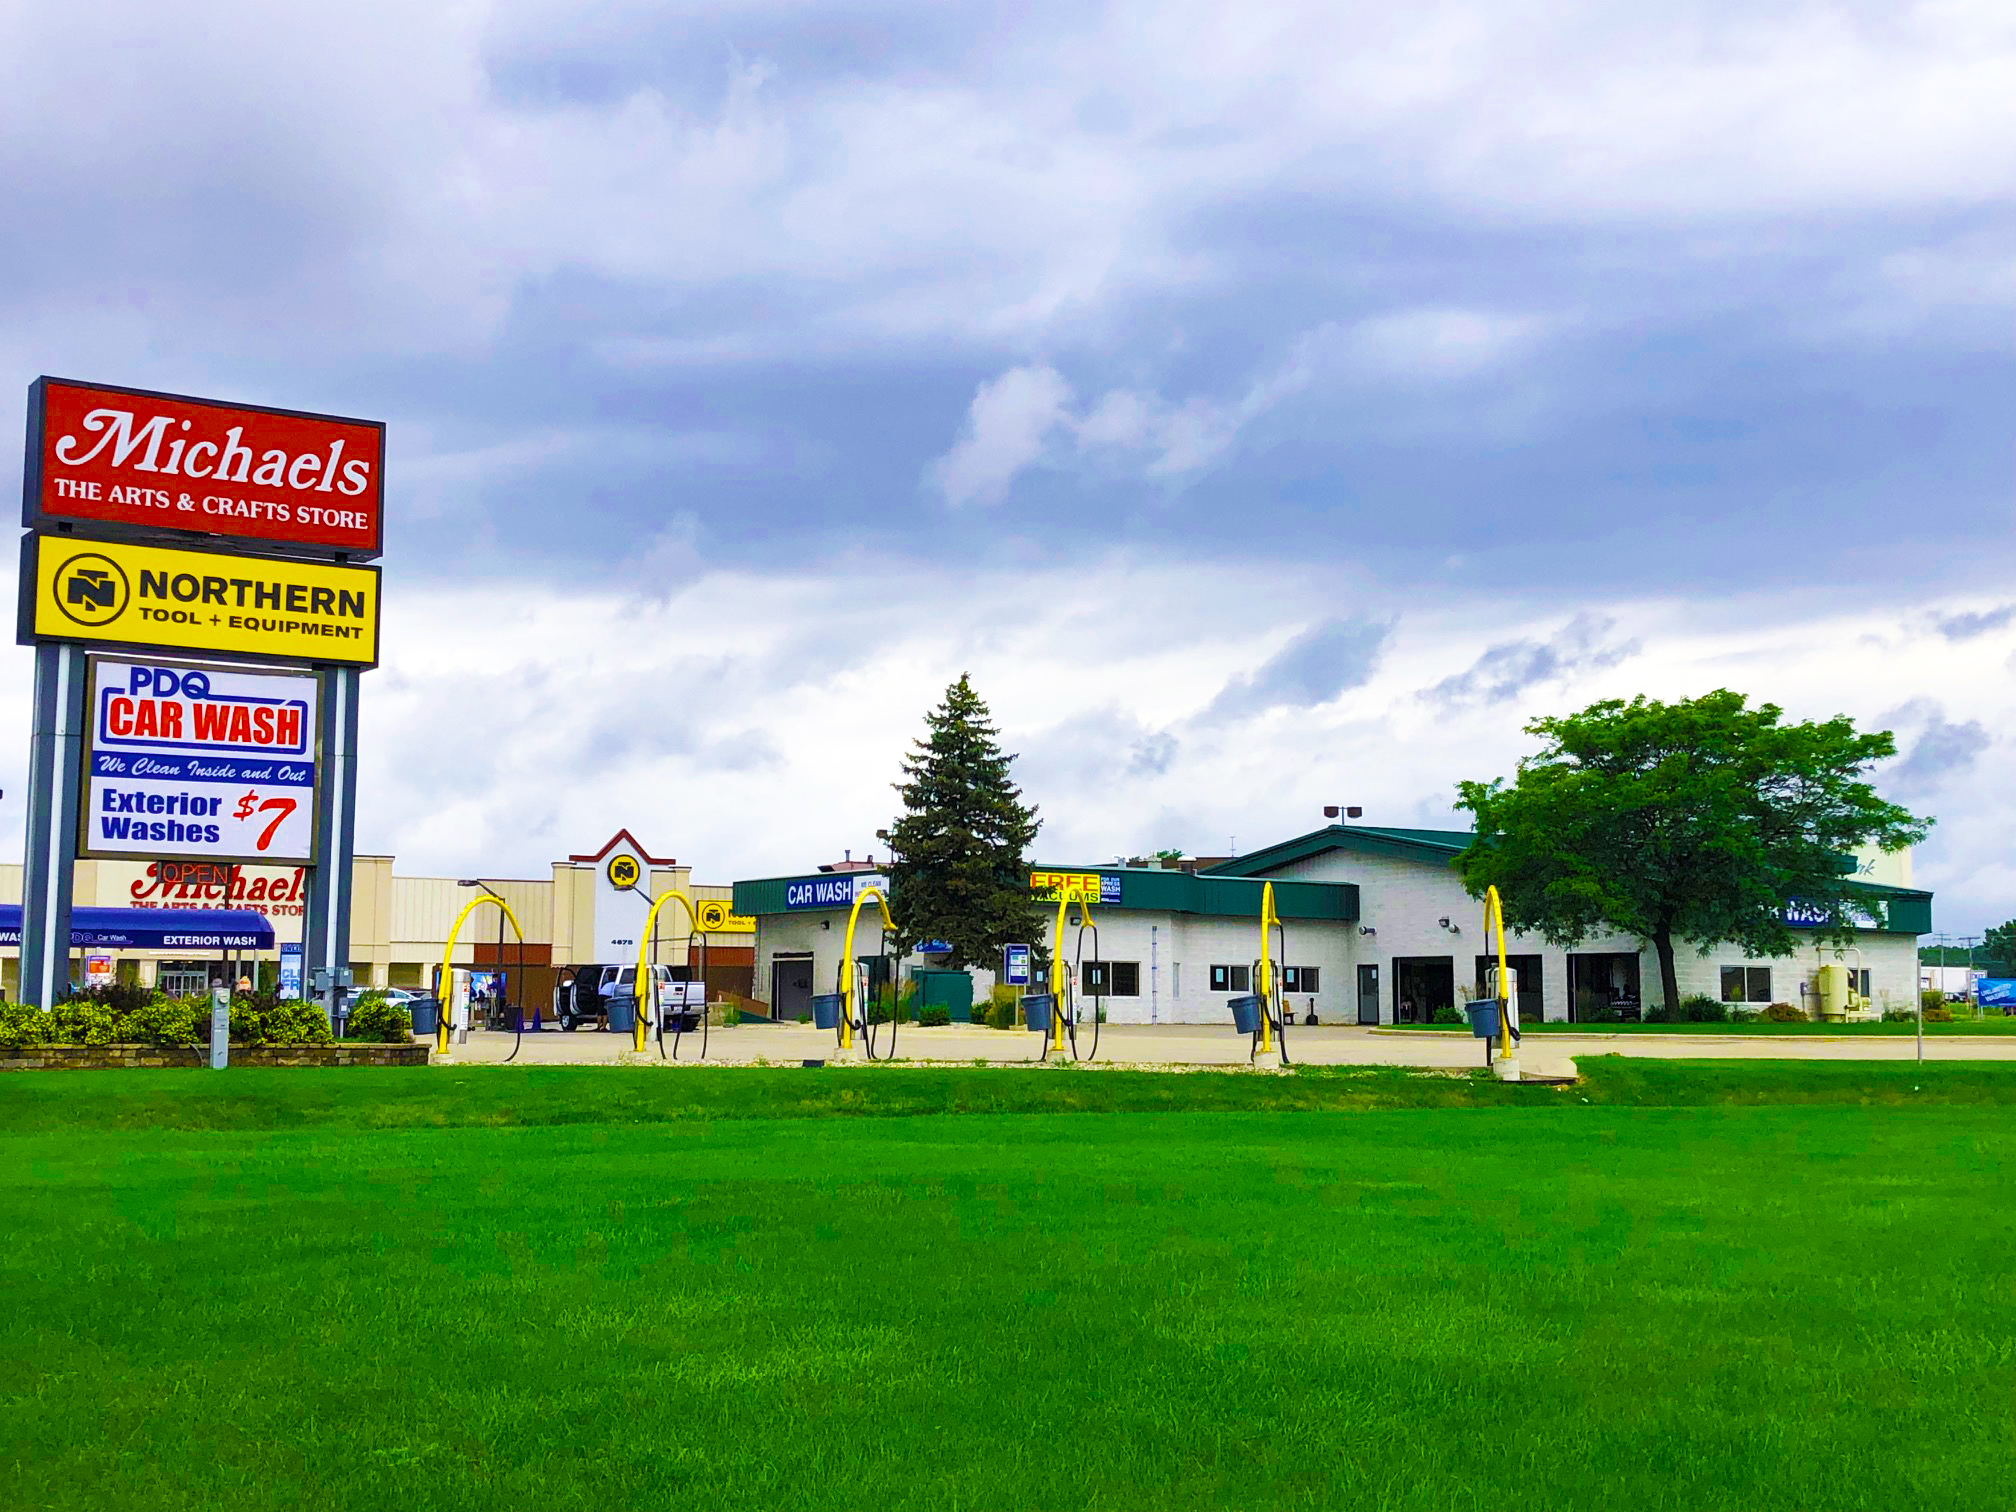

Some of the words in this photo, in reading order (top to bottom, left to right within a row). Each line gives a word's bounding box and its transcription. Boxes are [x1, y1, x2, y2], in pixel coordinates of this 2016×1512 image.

[55, 408, 370, 496] Michaels
[54, 478, 102, 501] THE
[108, 485, 170, 508] ARTS
[177, 493, 195, 511] &
[202, 496, 290, 521] CRAFTS
[297, 506, 369, 530] STORE
[139, 569, 365, 618] NORTHERN
[138, 607, 202, 625] TOOL
[209, 614, 222, 627] +
[229, 615, 364, 639] EQUIPMENT
[129, 666, 211, 699] PDQ
[109, 697, 183, 739] CAR
[193, 703, 299, 745] WASH
[99, 755, 126, 772] We
[131, 757, 181, 776] Clean
[187, 760, 236, 778] Inside
[241, 767, 272, 780] and
[277, 765, 307, 781] Out
[102, 788, 223, 817] Exterior
[101, 816, 220, 843] Washes
[162, 863, 229, 884] OPEN
[1031, 874, 1099, 892] FREE
[788, 884, 813, 905] CAR
[816, 880, 852, 902] WASH
[0, 932, 21, 942] WAS
[70, 931, 94, 943] DQ
[163, 935, 221, 946] EXTERIOR
[223, 936, 257, 946] WASH
[281, 979, 299, 990] FR
[282, 968, 300, 978] CL
